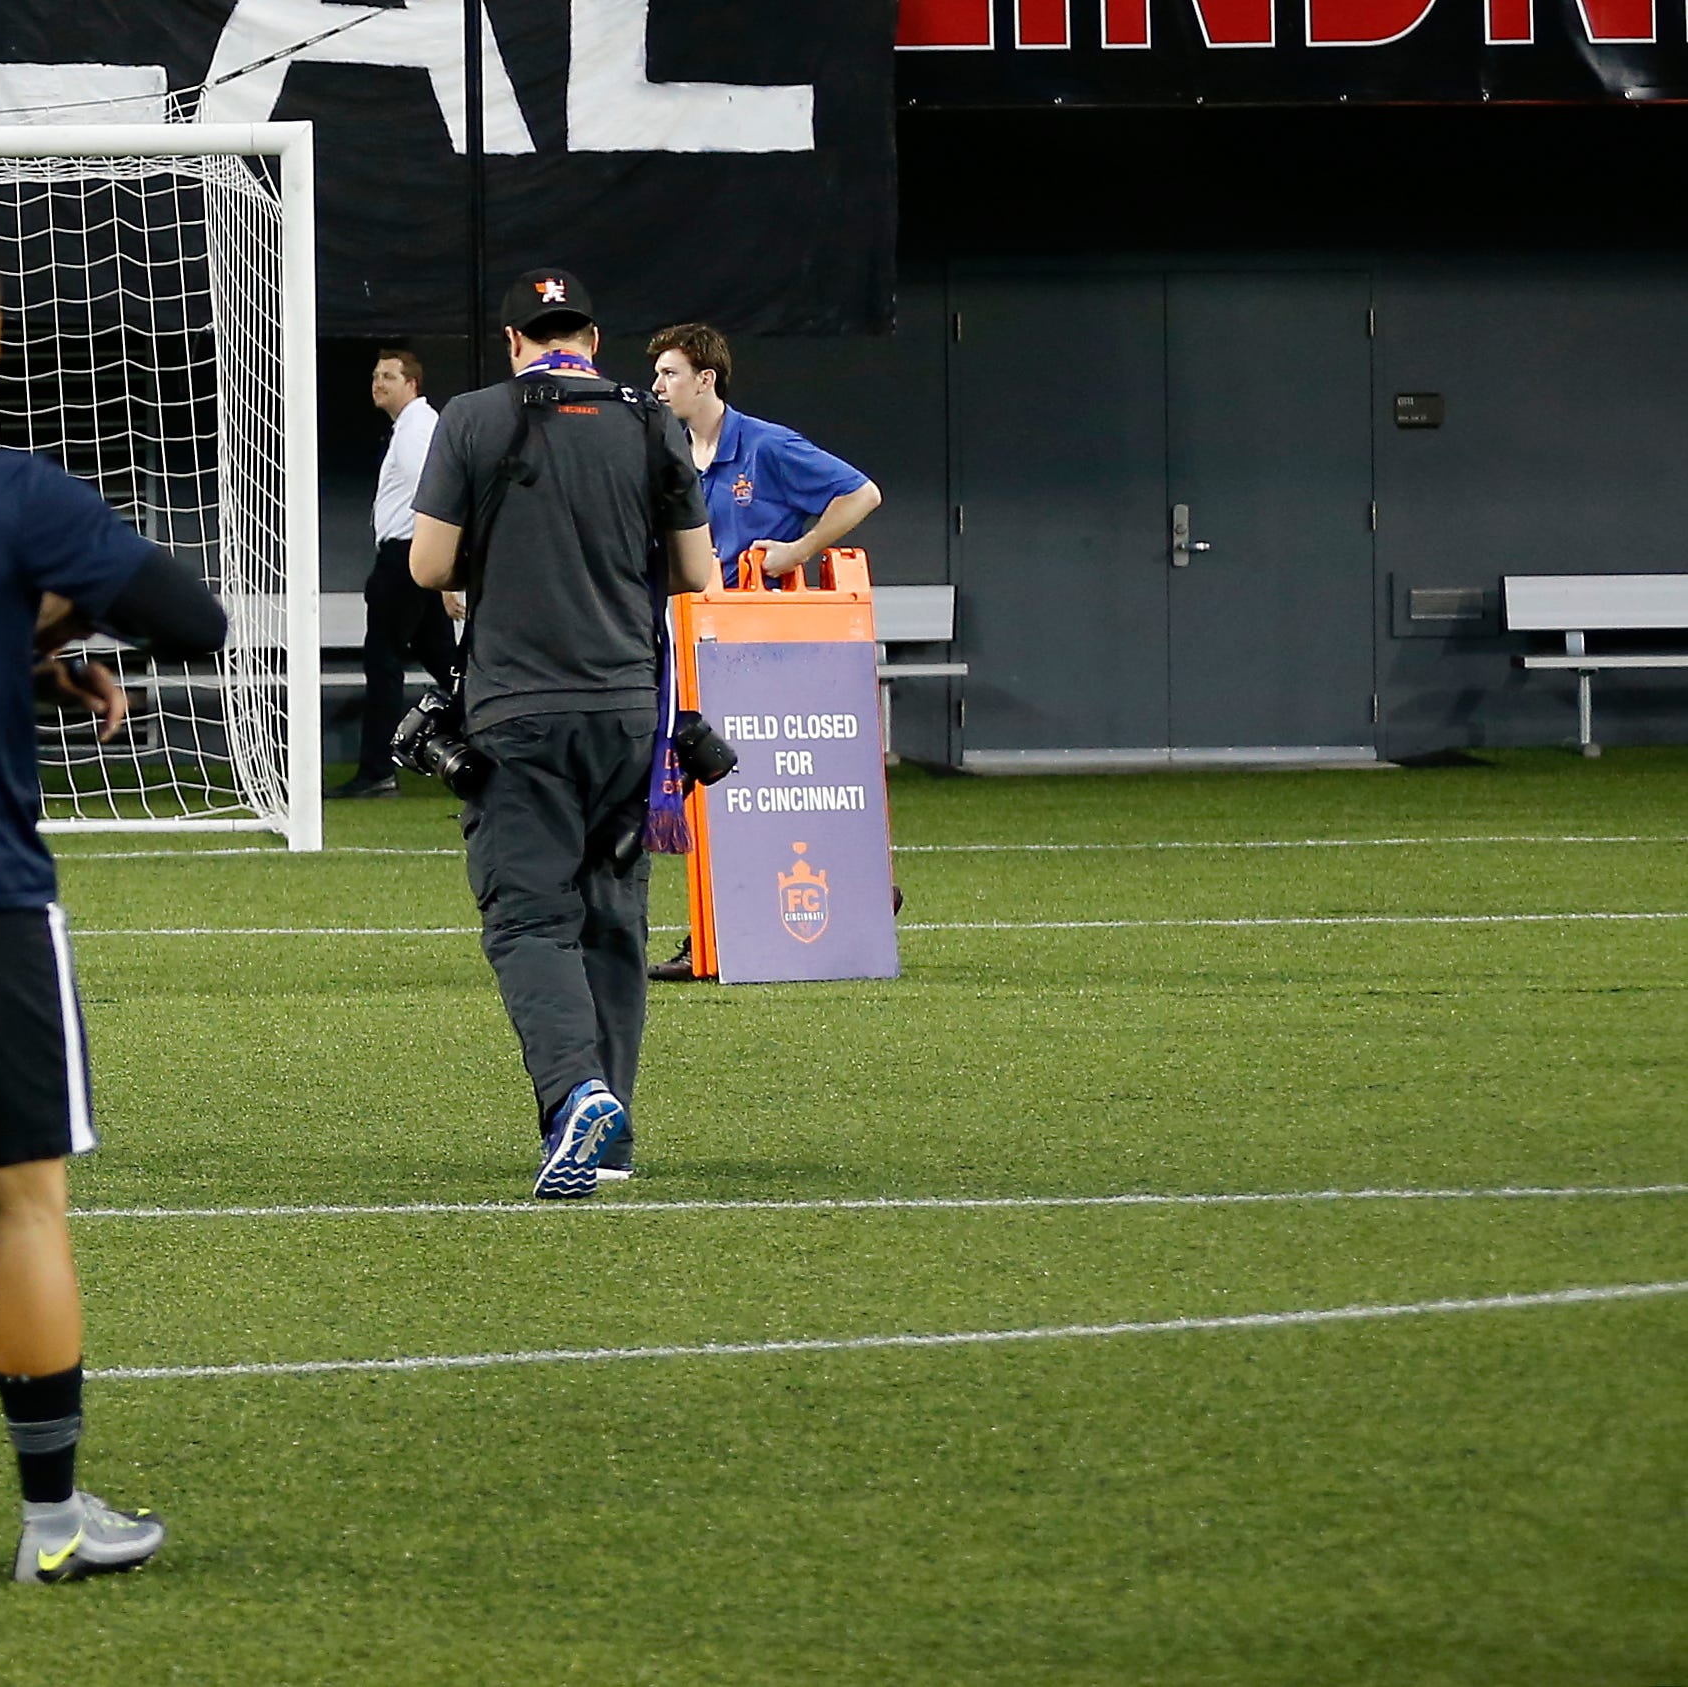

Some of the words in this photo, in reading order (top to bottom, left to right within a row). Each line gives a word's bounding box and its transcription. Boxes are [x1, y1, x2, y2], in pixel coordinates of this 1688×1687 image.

[723, 714, 778, 741] FIELD
[783, 713, 858, 740] CLOSED
[774, 751, 813, 777] FOR
[727, 788, 752, 814] FC
[756, 785, 866, 813] CINCINNATI
[787, 888, 820, 913] FC
[784, 912, 824, 922] CINCINNATI
